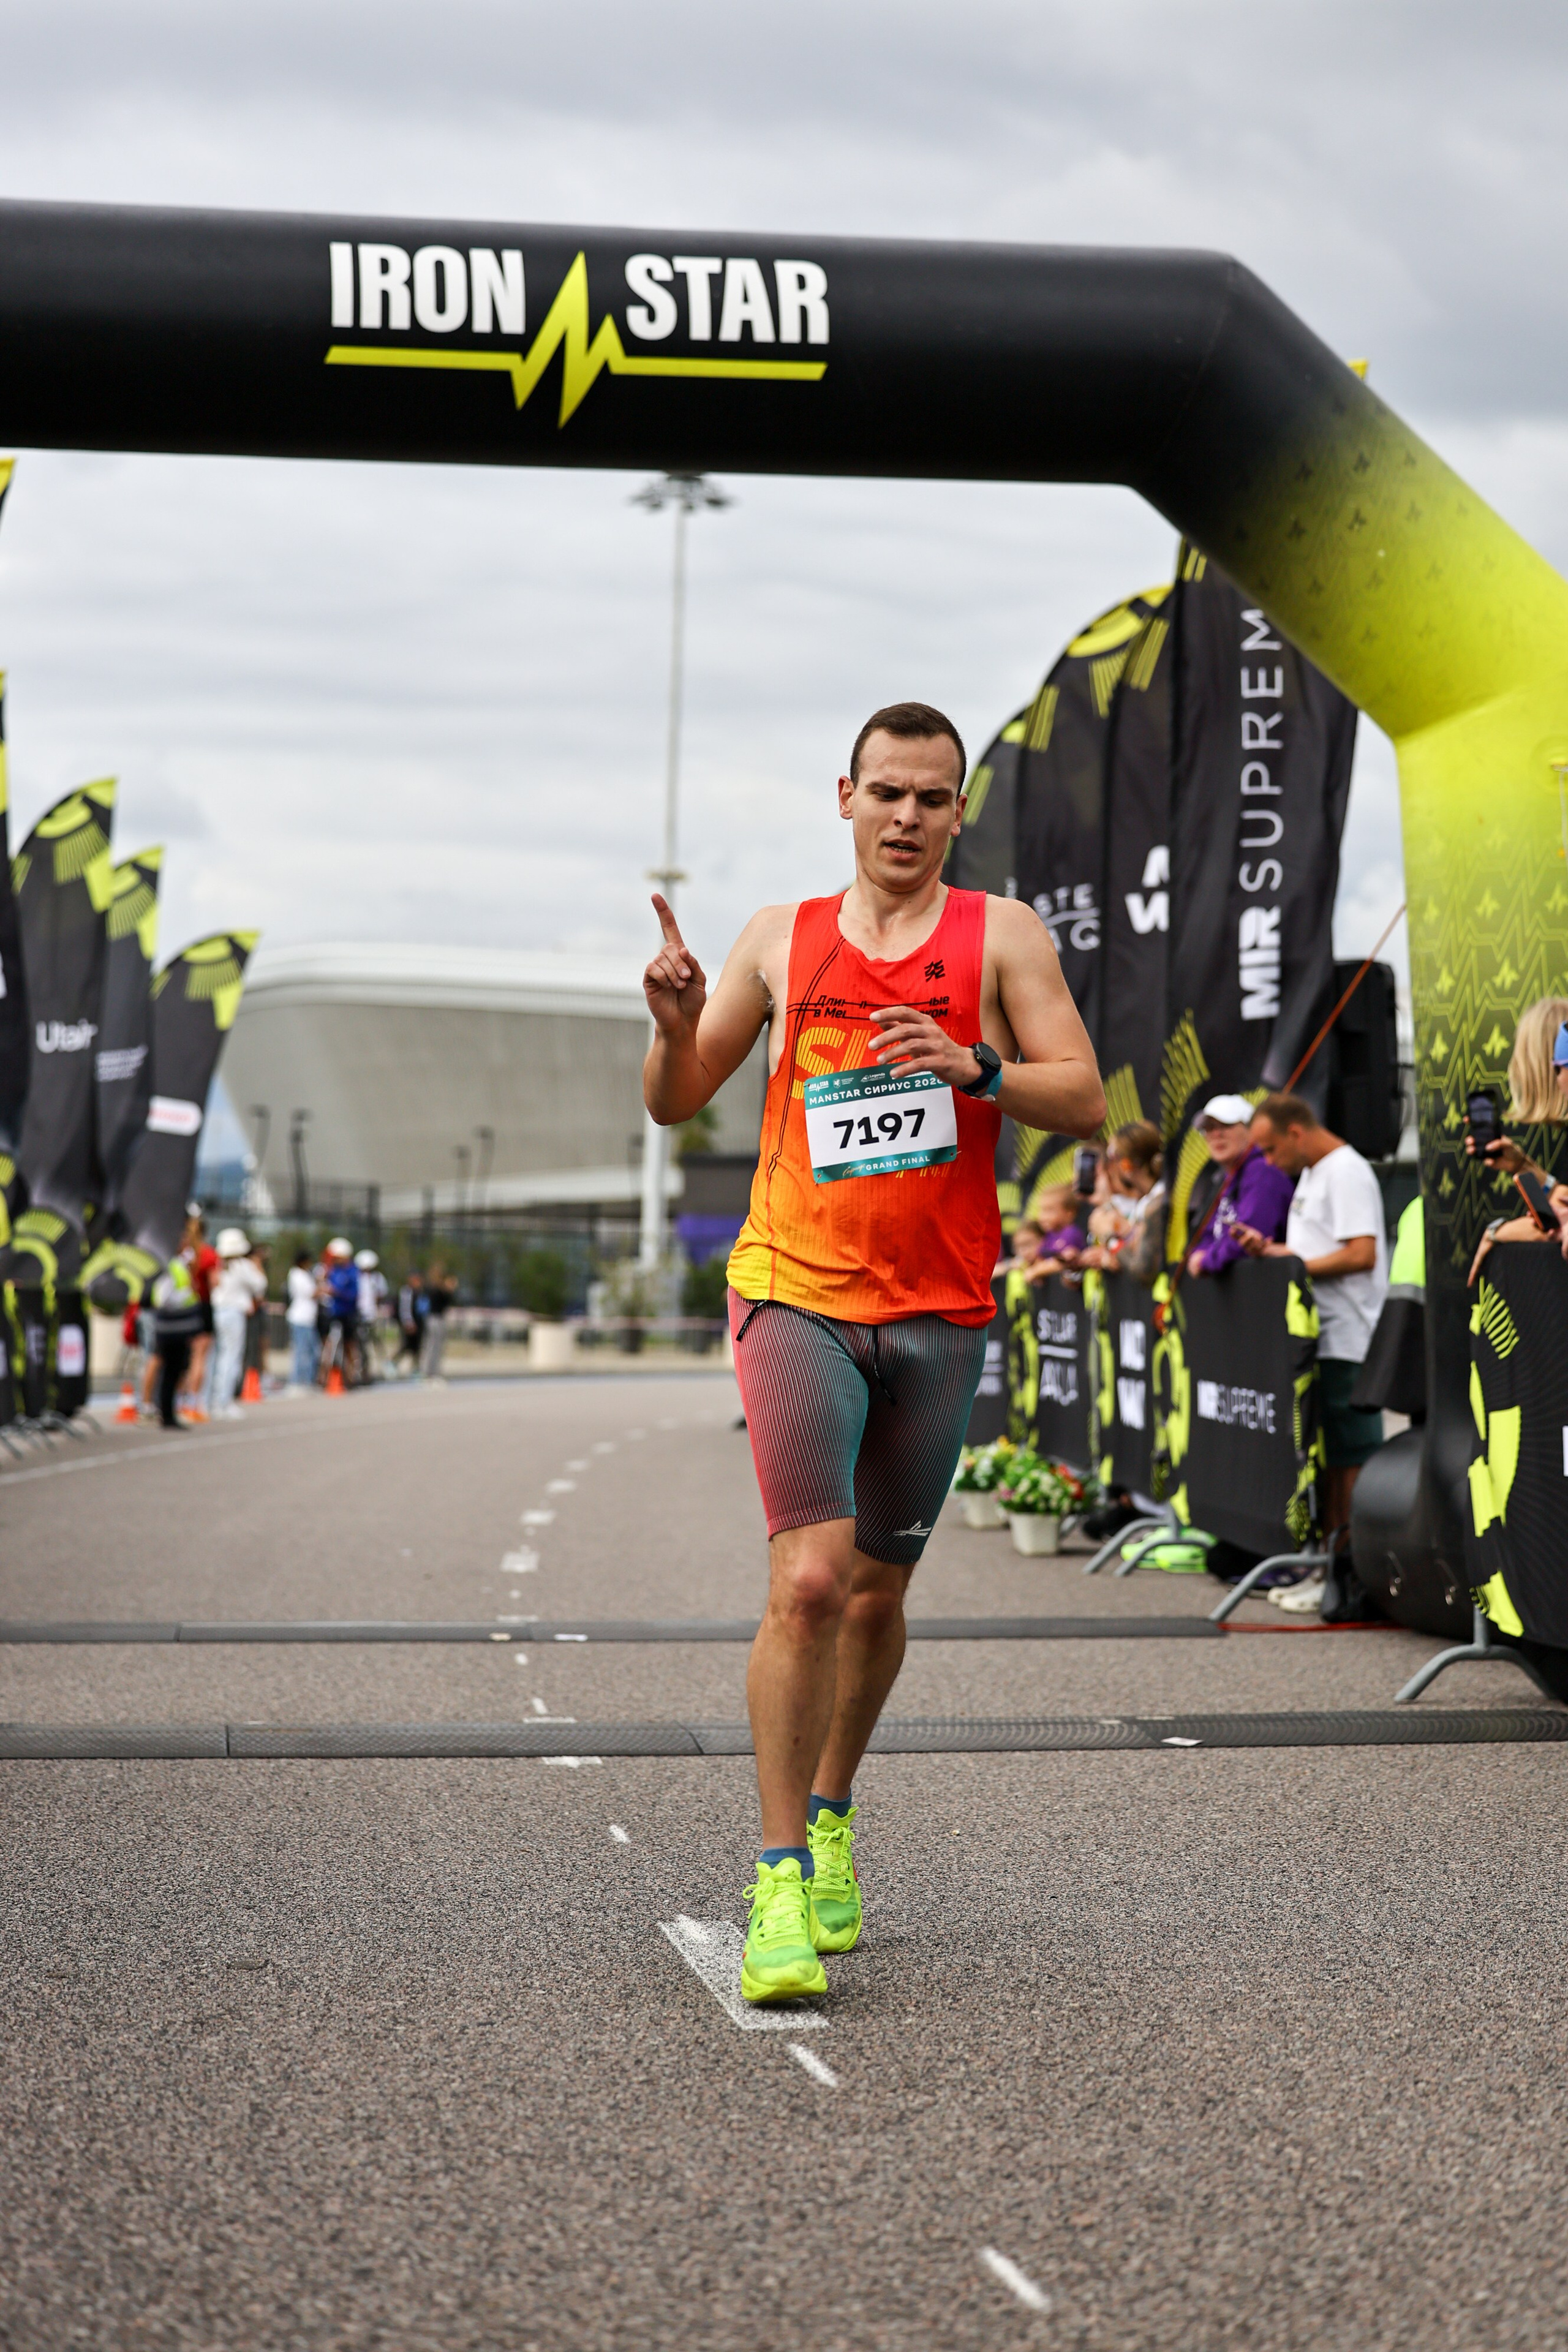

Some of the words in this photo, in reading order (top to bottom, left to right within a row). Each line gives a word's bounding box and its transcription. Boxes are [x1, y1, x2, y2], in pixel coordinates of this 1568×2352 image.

[329, 241, 526, 334] IRON
[624, 253, 830, 345] STAR
[809, 1089, 861, 1105] MANSTAR
[864, 1081, 911, 1095] СИРИУС
[833, 1108, 925, 1149] 7197
[865, 1160, 899, 1170] GRAND
[902, 1155, 930, 1166] FINAL
